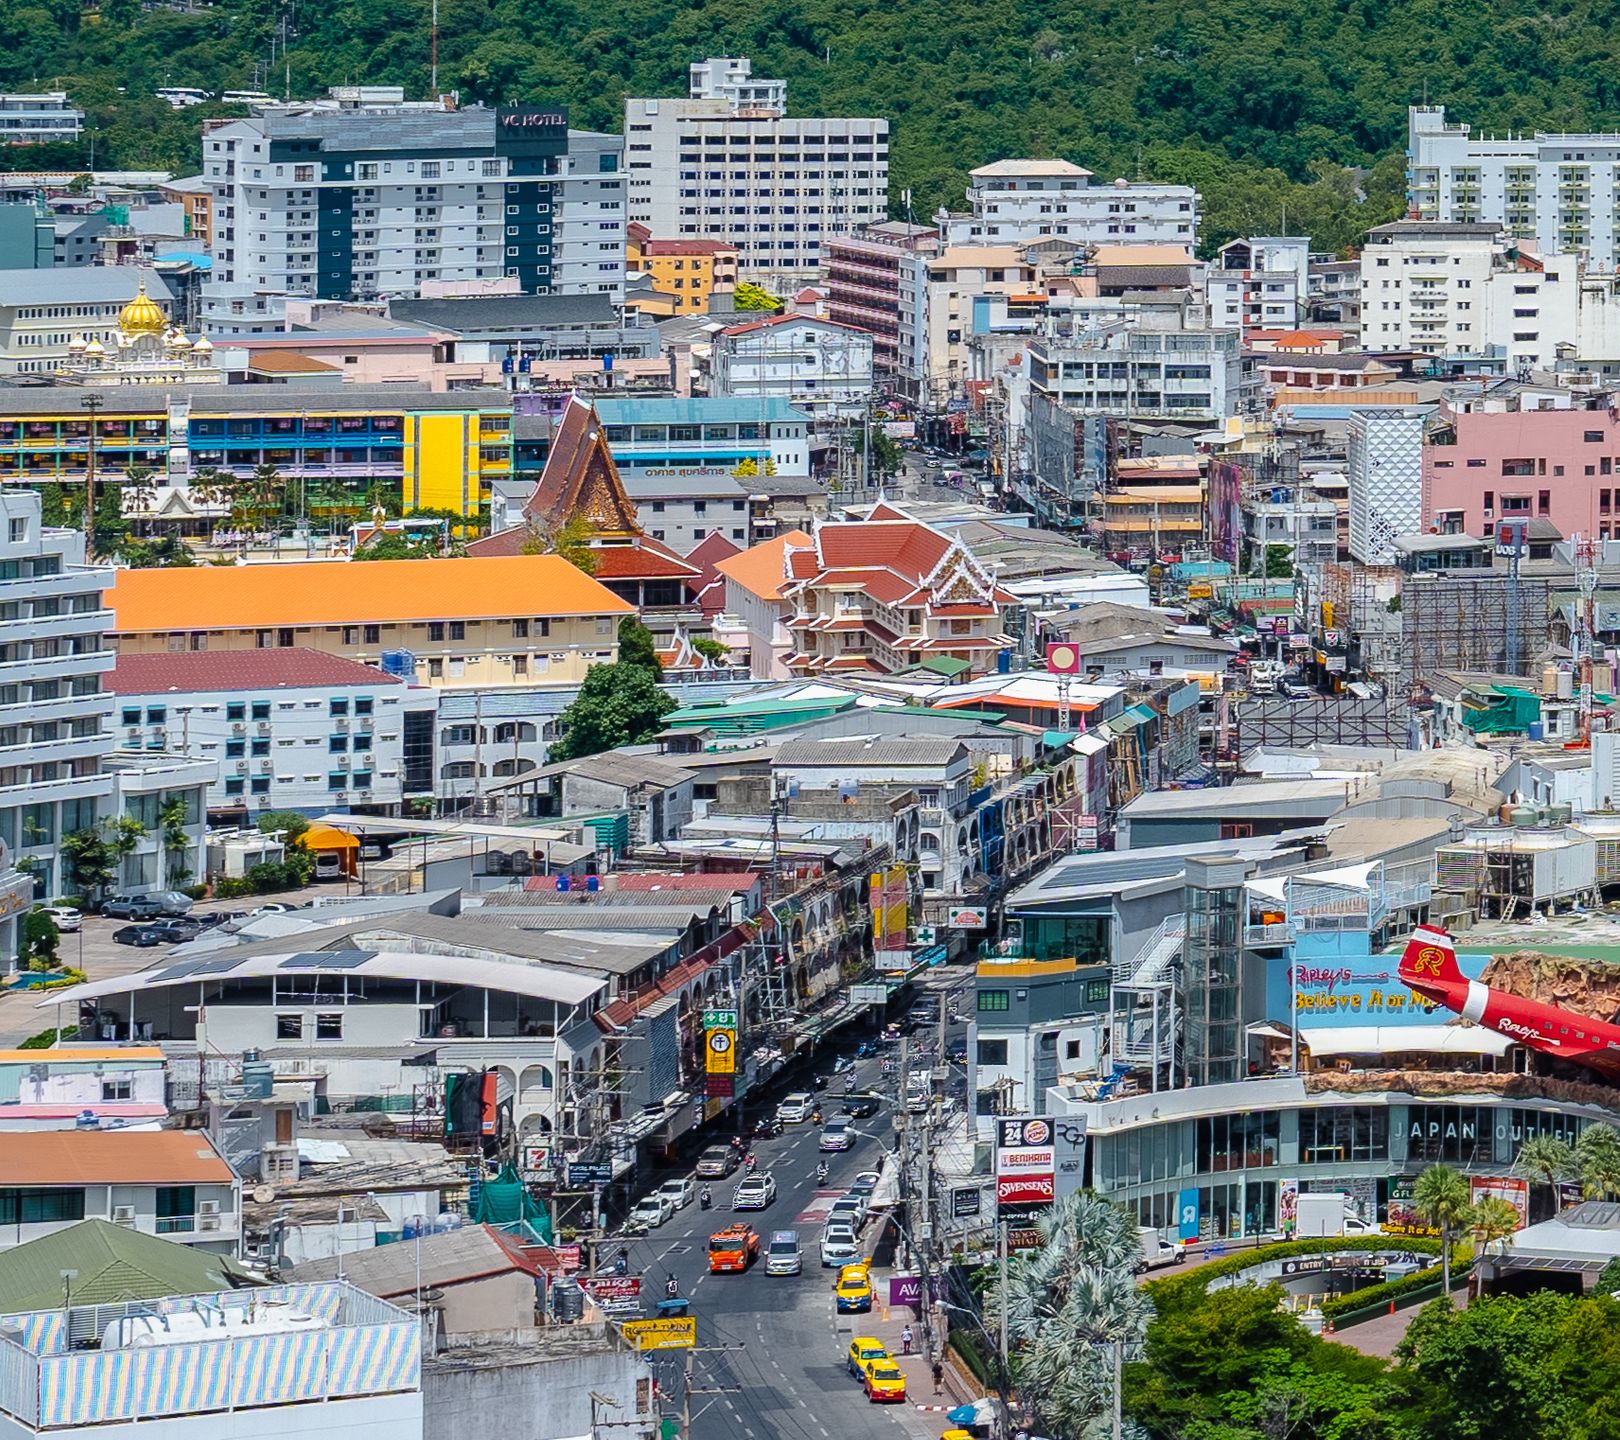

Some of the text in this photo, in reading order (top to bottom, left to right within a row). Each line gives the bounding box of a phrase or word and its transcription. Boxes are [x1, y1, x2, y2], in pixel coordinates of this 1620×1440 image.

[502, 113, 567, 127] VC HOTEL
[1288, 965, 1352, 993] Ripley's
[1294, 990, 1361, 1009] Believe
[1368, 989, 1382, 1007] It
[1385, 994, 1406, 1008] or
[1005, 1128, 1022, 1140] 24
[1394, 1121, 1475, 1138] JAPAN
[1009, 1153, 1052, 1163] BENIHANA
[999, 1180, 1054, 1197] SWENSEN'S
[1300, 1261, 1323, 1271] ENTRY
